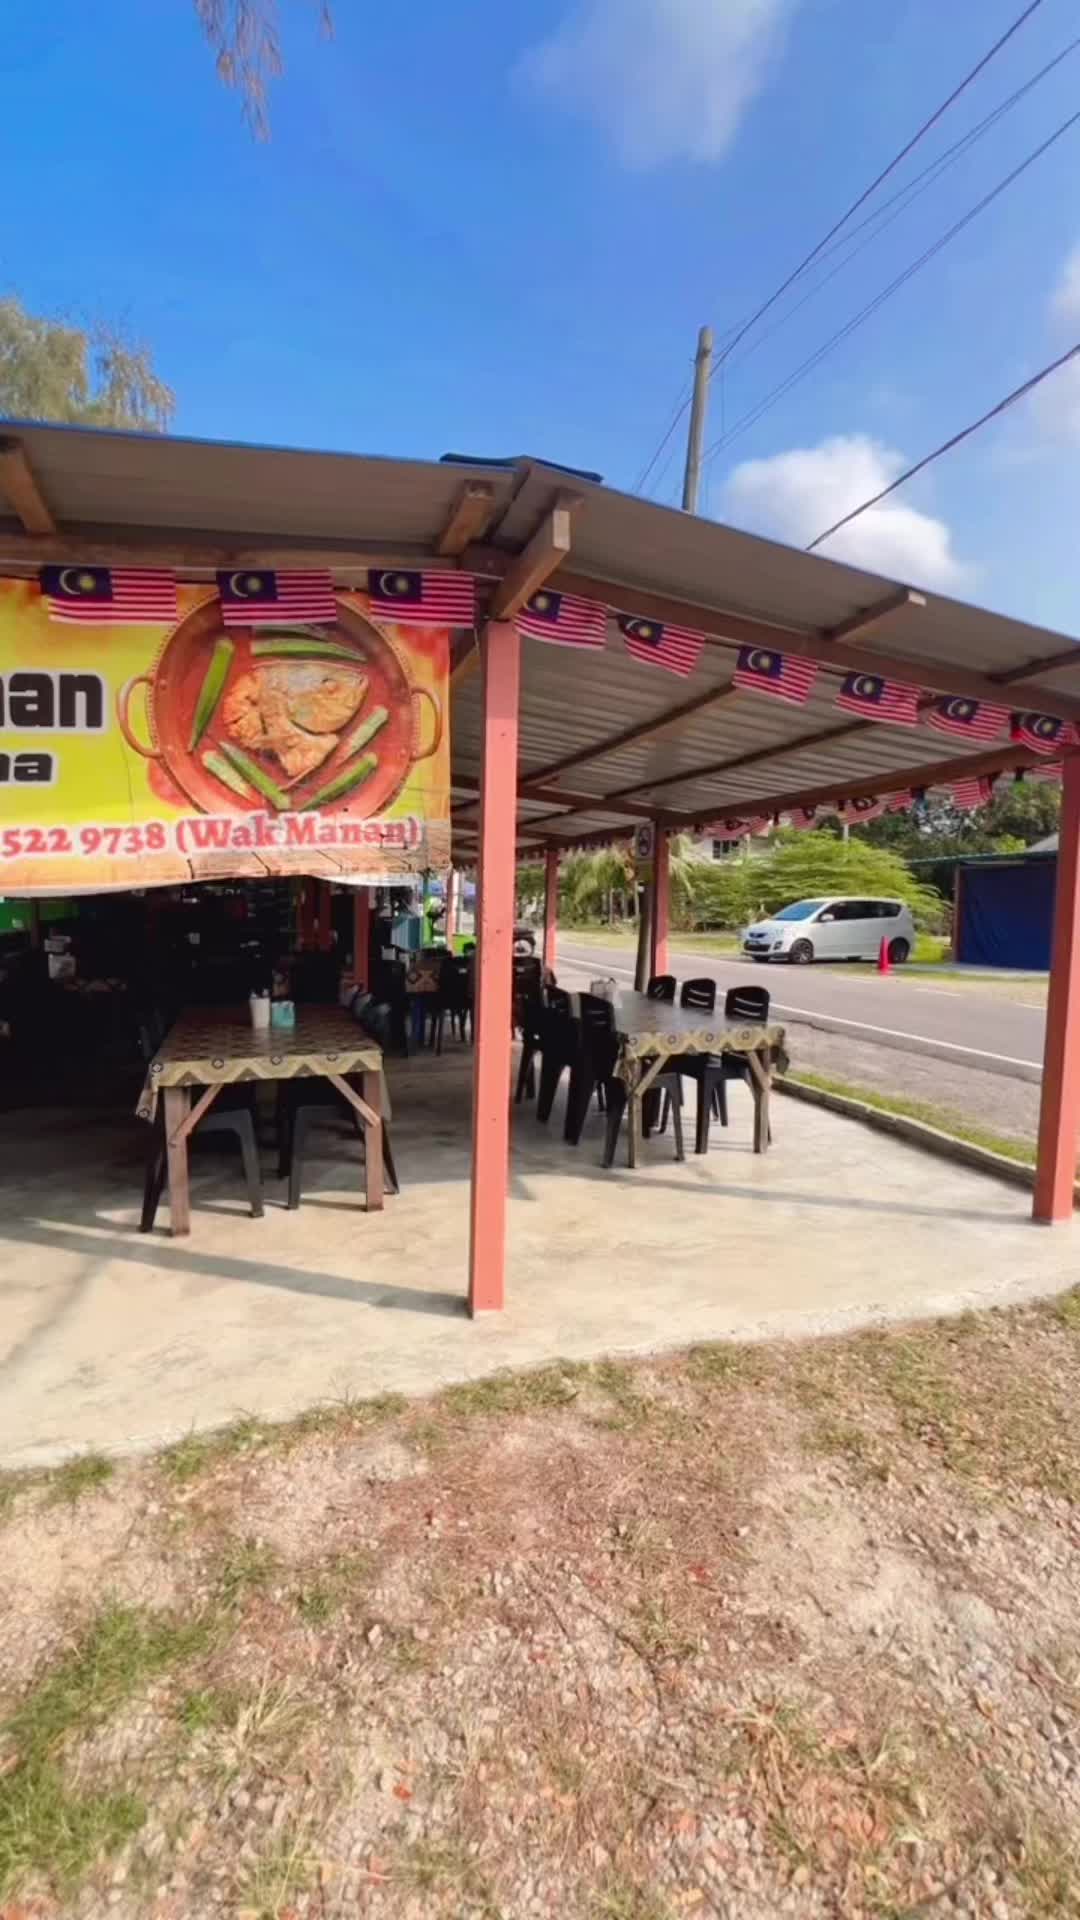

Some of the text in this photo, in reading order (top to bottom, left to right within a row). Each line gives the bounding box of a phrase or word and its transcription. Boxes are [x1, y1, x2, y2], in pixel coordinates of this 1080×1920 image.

[0, 673, 103, 728] an
[0, 752, 53, 782] a
[2, 814, 419, 857] 522 9738 (Wak Manan)
